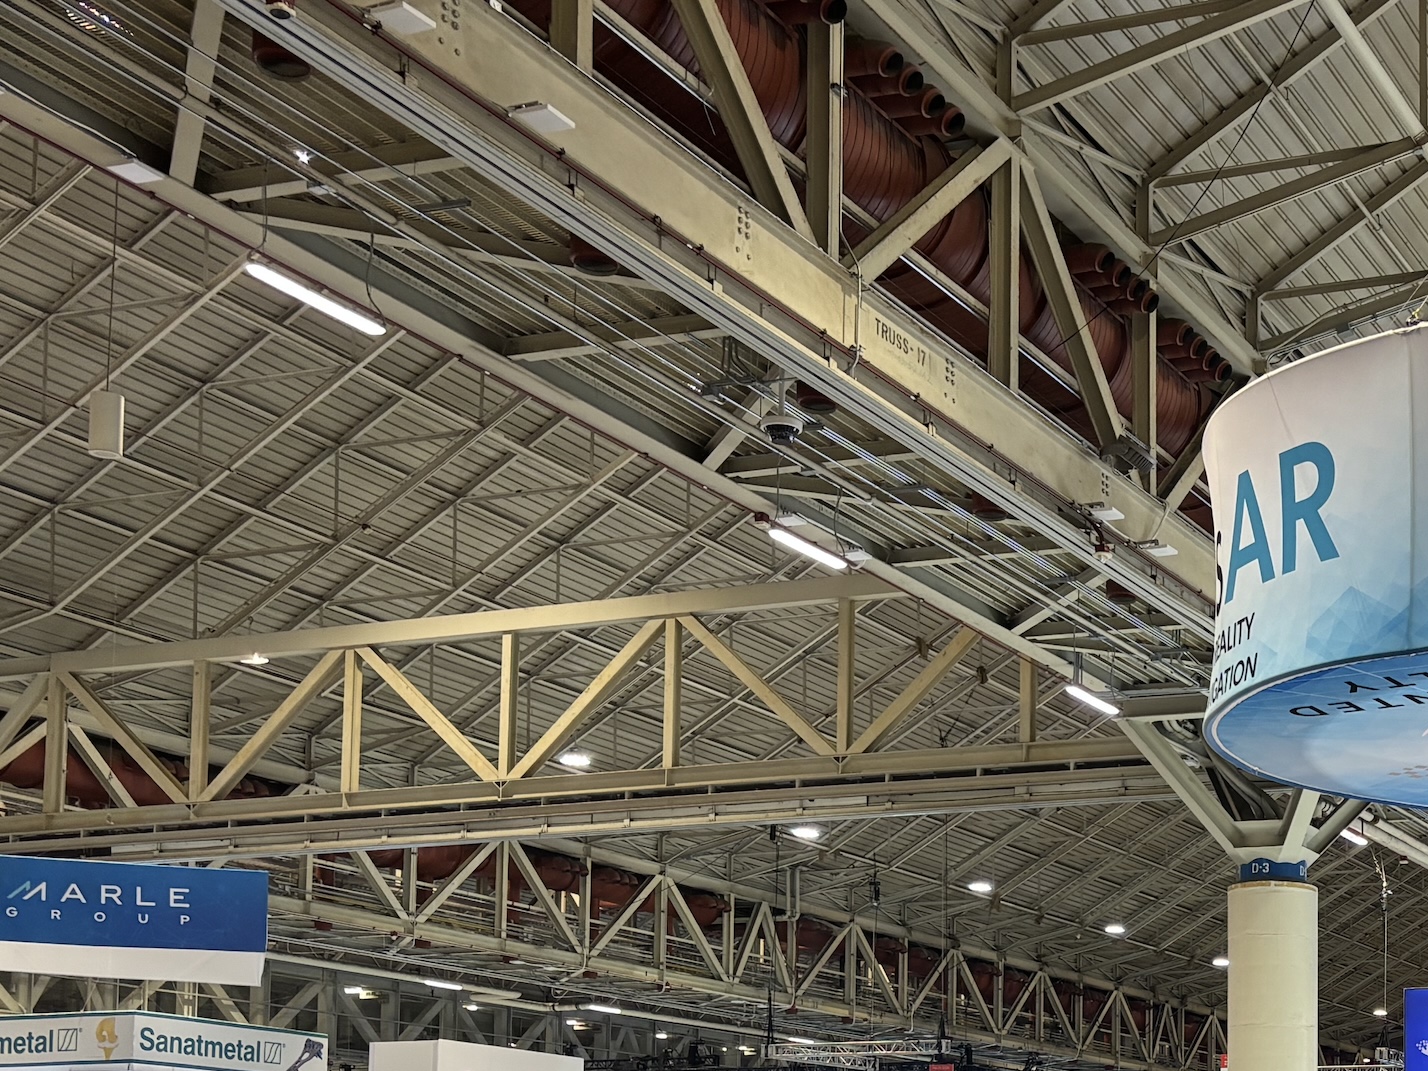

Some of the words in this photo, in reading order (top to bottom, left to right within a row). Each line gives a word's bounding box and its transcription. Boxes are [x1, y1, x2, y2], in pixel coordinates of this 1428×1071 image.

[6, 880, 190, 908] MARLE
[6, 907, 190, 925] GROUP
[139, 1027, 260, 1063] Sanatmetal
